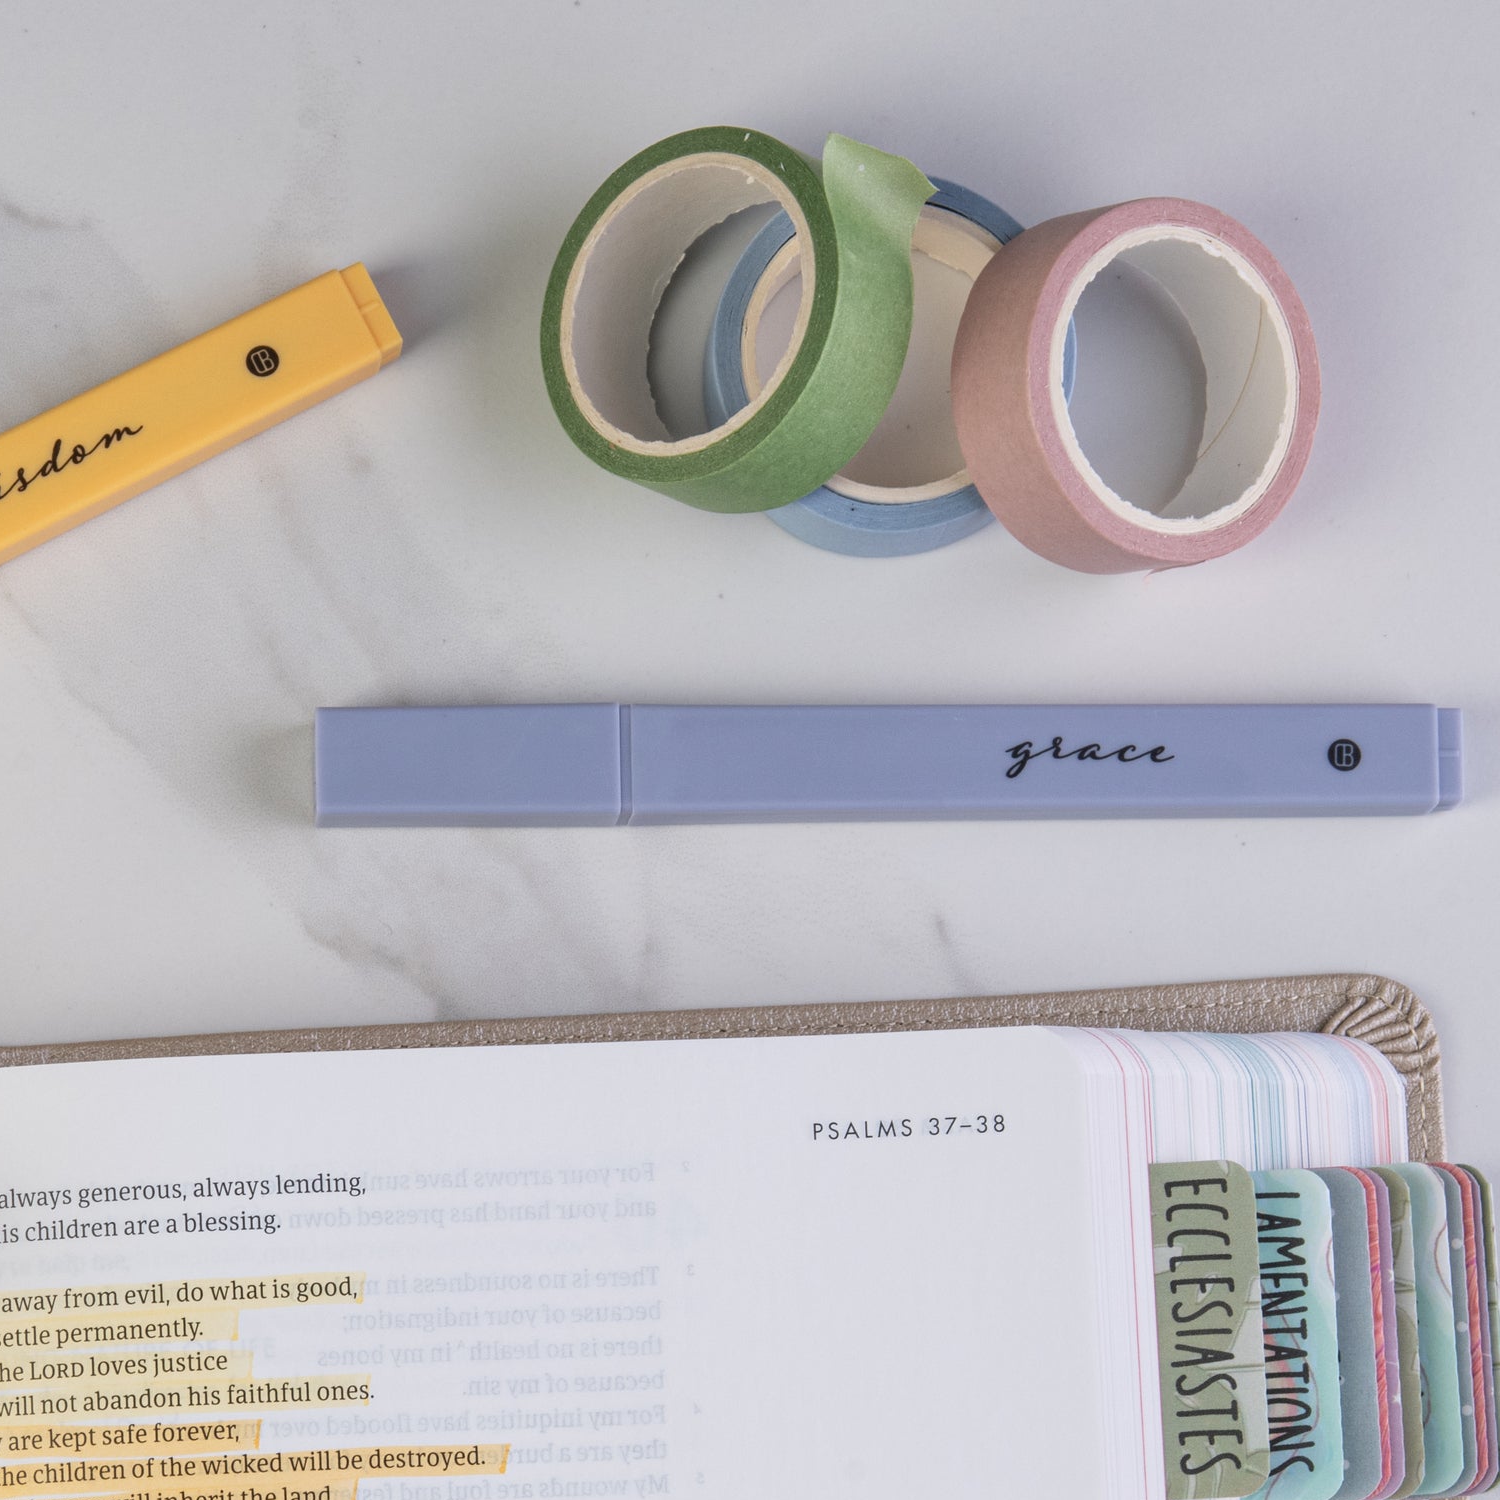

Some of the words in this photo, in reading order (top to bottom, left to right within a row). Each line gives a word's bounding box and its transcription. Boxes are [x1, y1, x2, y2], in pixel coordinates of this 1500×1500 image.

[1004, 736, 1175, 779] grace
[812, 1118, 913, 1141] PSALMS
[77, 1183, 187, 1209] generous,
[192, 1177, 271, 1201] always
[275, 1172, 366, 1197] lending,
[1, 1294, 59, 1315] away
[63, 1287, 120, 1309] from
[124, 1283, 170, 1307] evil,
[176, 1281, 204, 1303] do
[208, 1279, 268, 1301] what
[271, 1278, 291, 1299] is
[296, 1275, 358, 1303] good,
[1164, 1178, 1244, 1475] ECCLESIASTES
